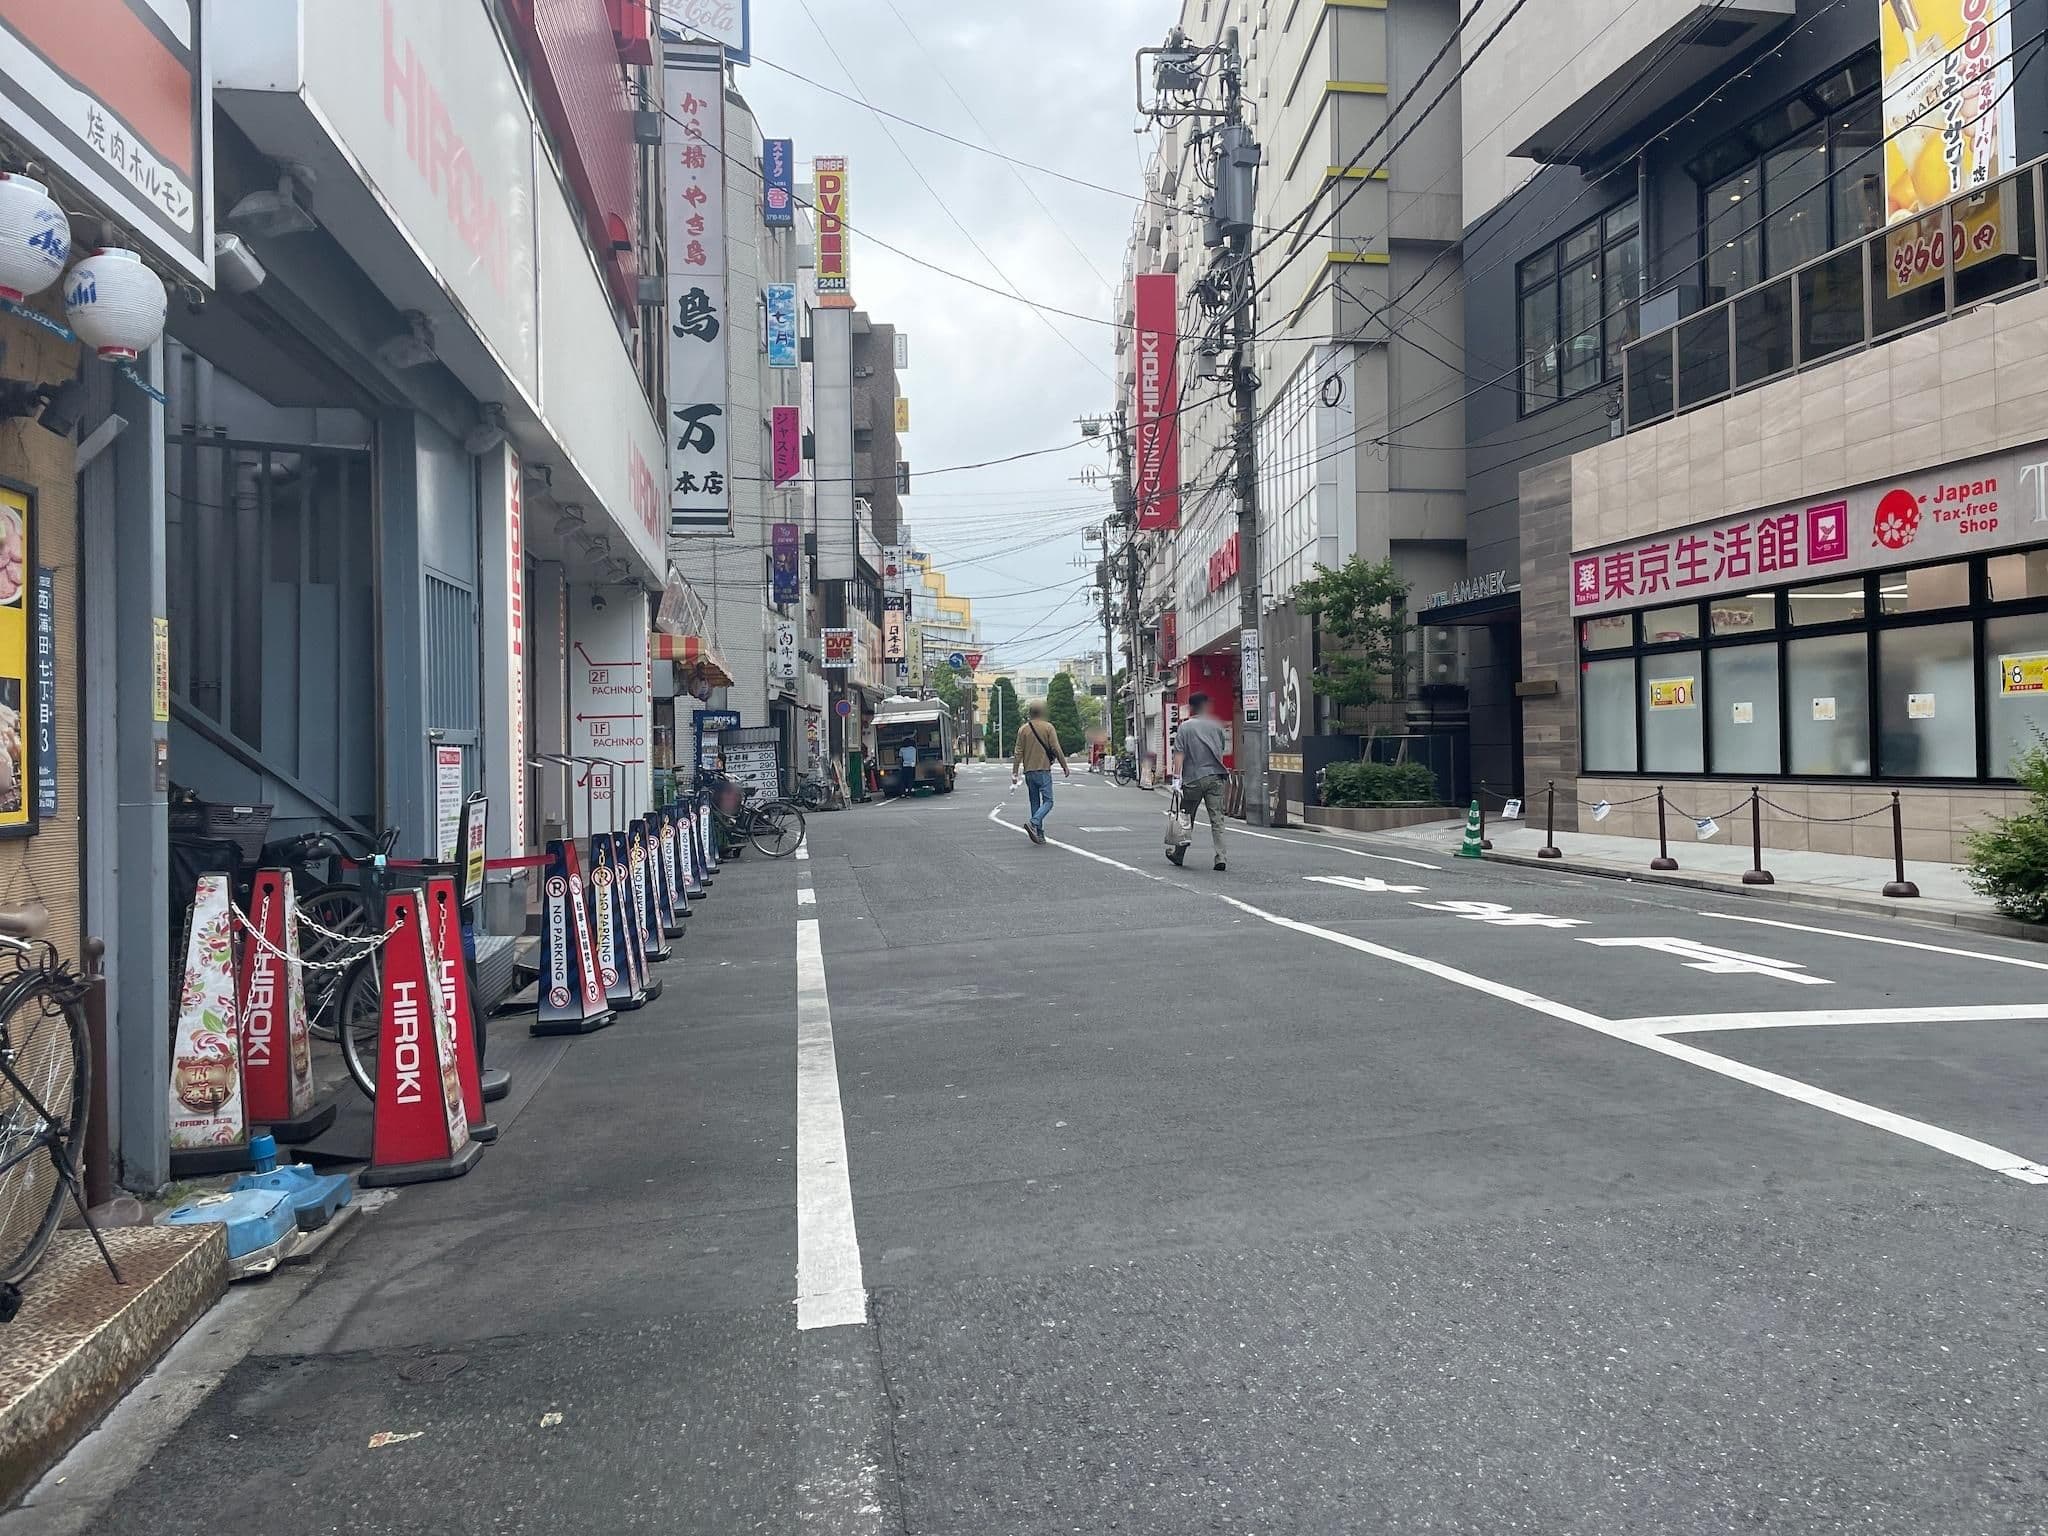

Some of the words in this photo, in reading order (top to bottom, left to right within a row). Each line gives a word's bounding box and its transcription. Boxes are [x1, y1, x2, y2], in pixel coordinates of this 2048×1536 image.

[86, 102, 190, 219] 焼肉ホルモン
[817, 278, 846, 290] 24H
[1142, 332, 1160, 417] HIROKI
[674, 471, 724, 495] 本店
[1933, 478, 1997, 503] Japan
[1933, 501, 1998, 523] Tax-free
[1959, 518, 1998, 534] Shop
[1604, 513, 1799, 600] 東京生活館
[1451, 569, 1506, 605] AMANEK
[1579, 562, 1596, 593] 薬
[592, 673, 605, 683] 2F
[592, 686, 643, 696] PACHINKO
[594, 724, 606, 735] 1F
[593, 738, 644, 747] PACHINKO
[594, 777, 608, 788] B1
[553, 905, 562, 924] NO
[601, 914, 611, 963] PARKING
[554, 928, 564, 981] PARKING
[247, 953, 276, 1066] HIROKI
[392, 981, 421, 1104] HIROKI
